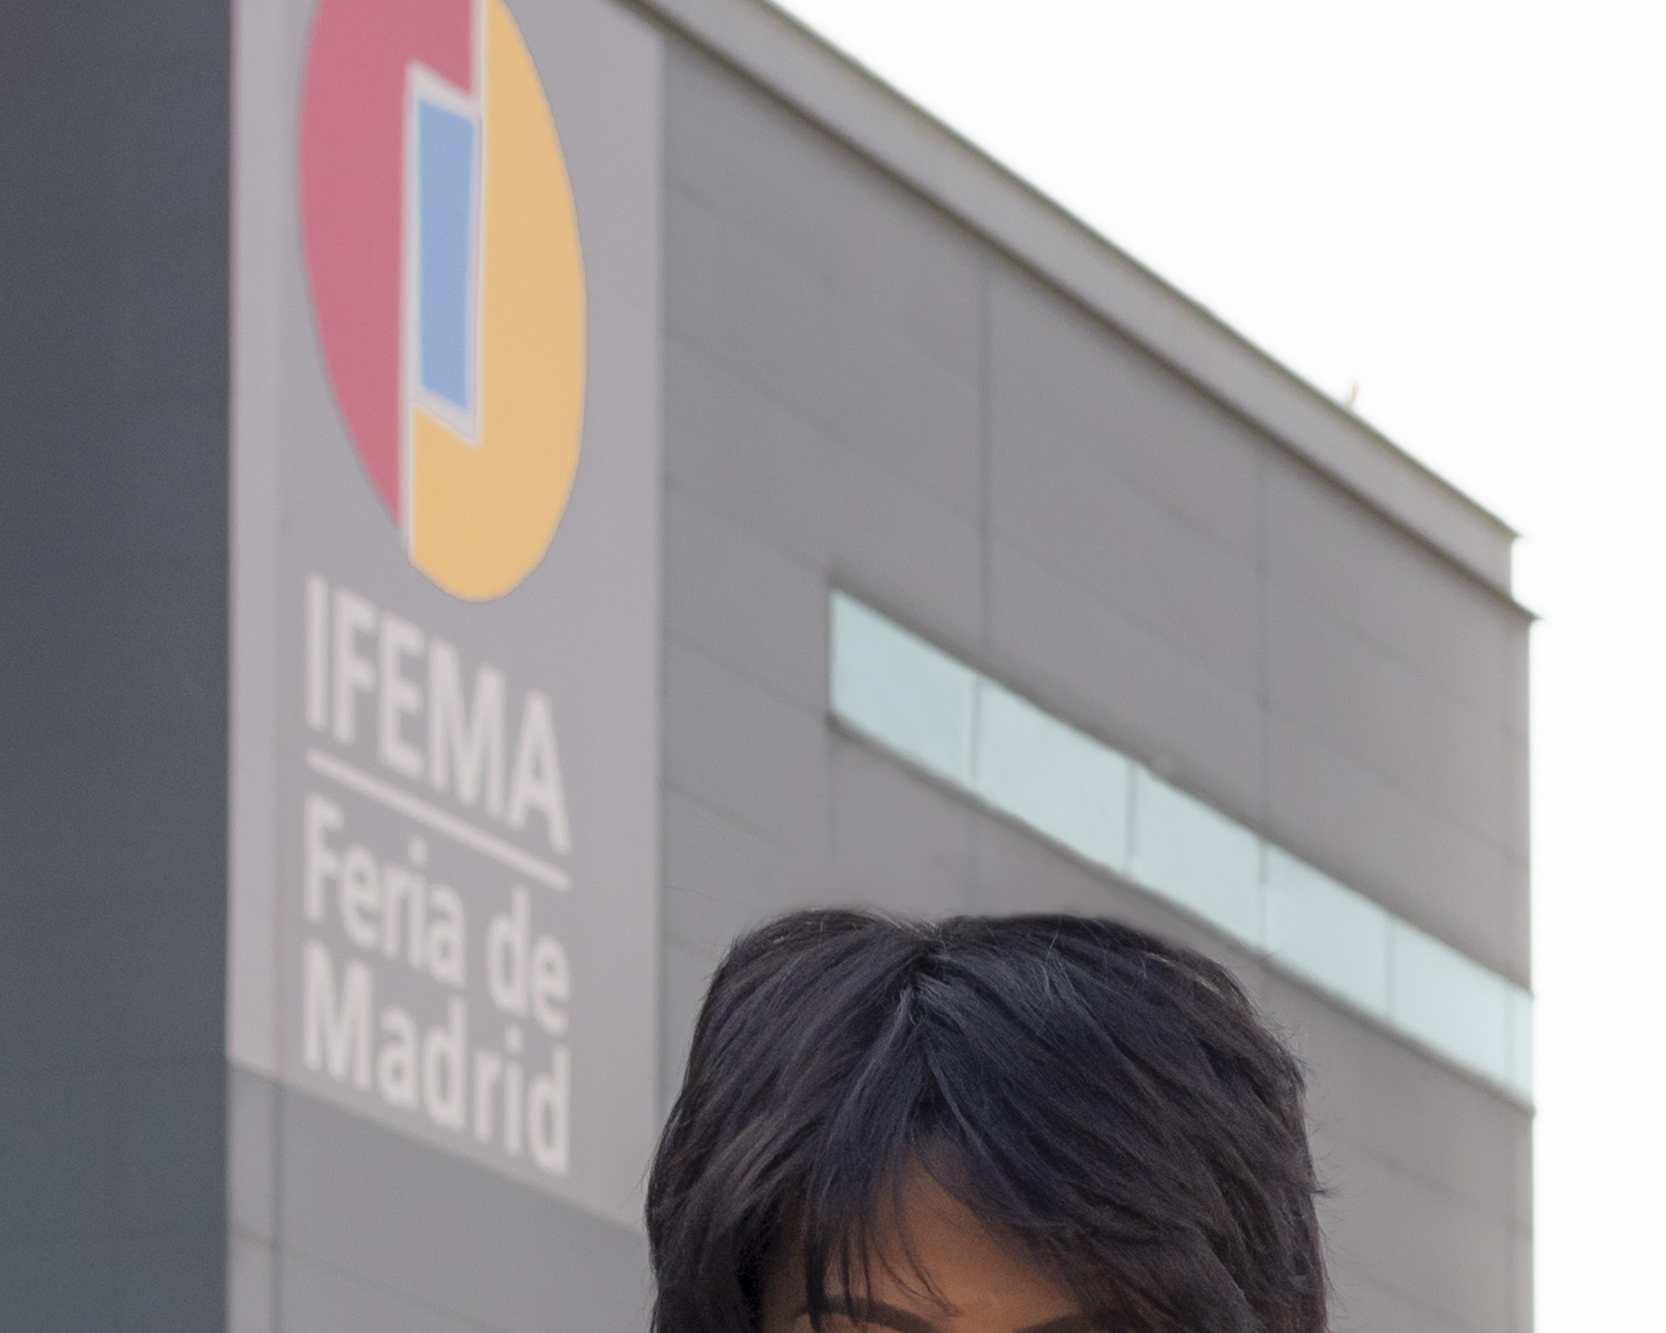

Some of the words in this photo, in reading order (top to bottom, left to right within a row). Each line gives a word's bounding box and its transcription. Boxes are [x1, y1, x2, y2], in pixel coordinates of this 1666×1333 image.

[304, 573, 571, 853] IFEMA
[303, 796, 466, 986] Feria
[487, 886, 570, 1035] de
[303, 938, 570, 1174] Madrid
